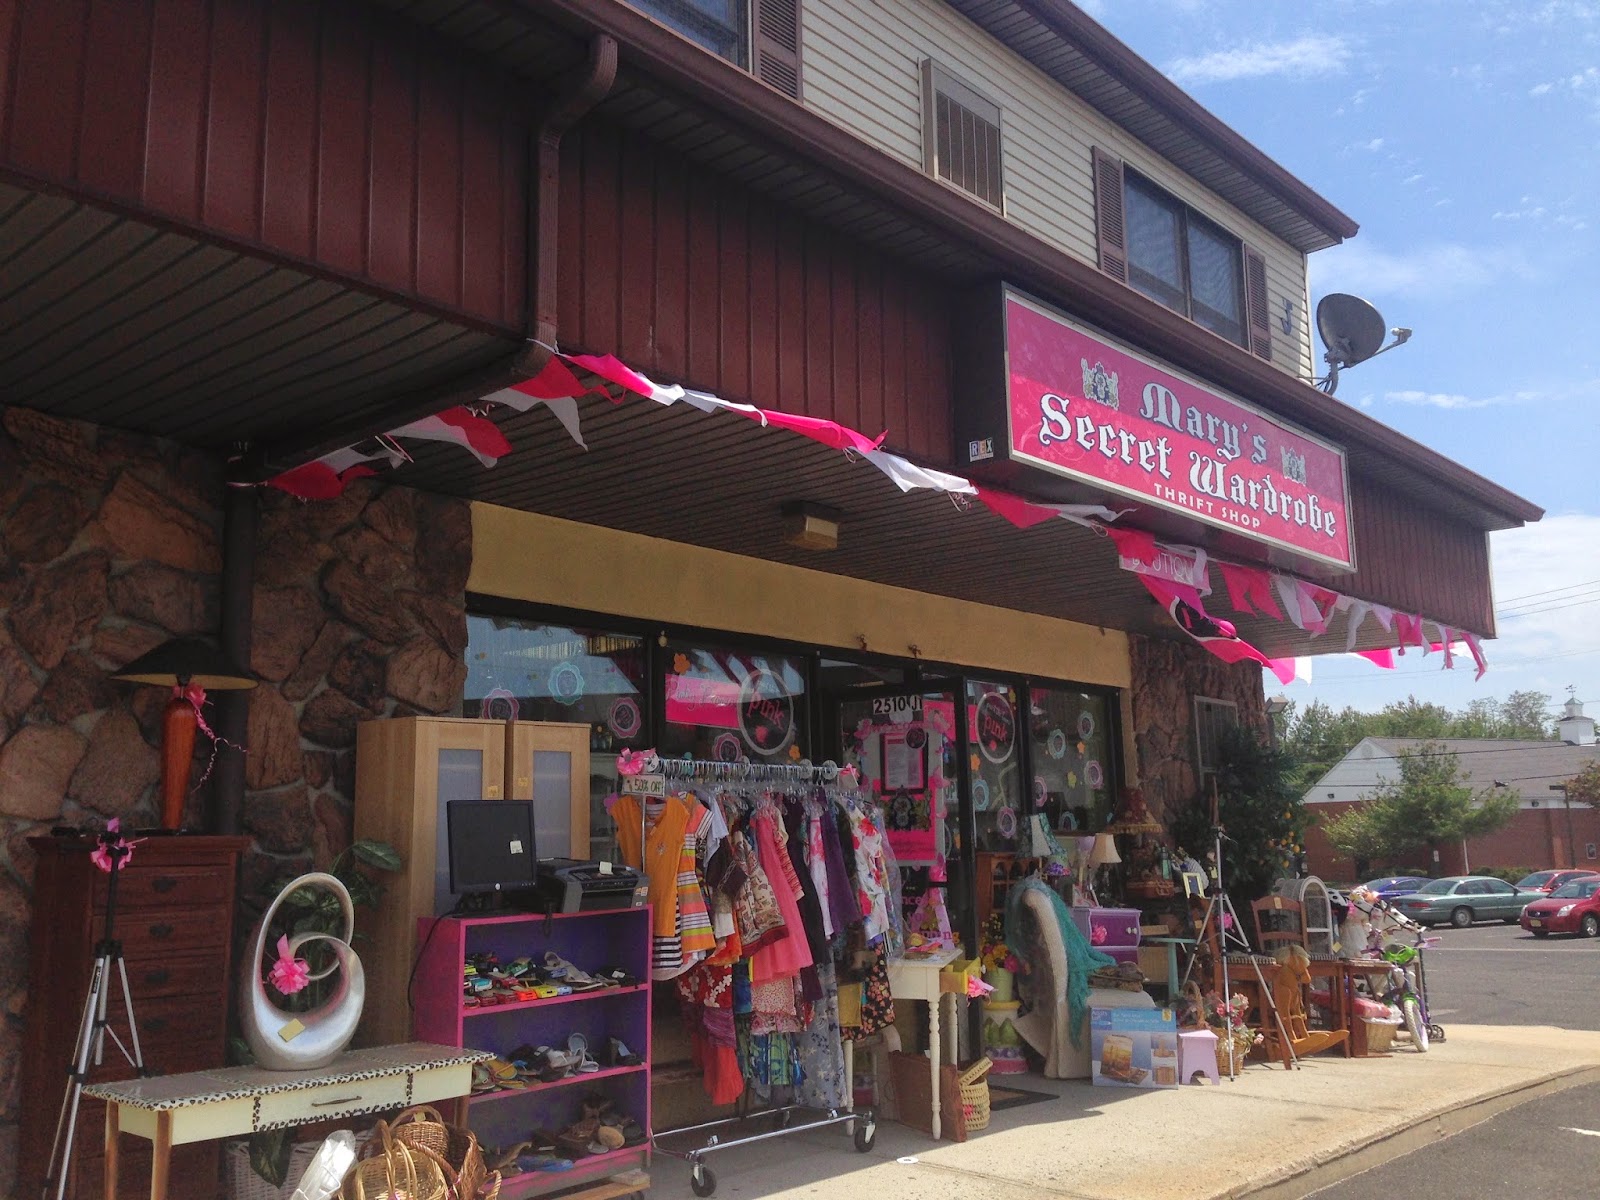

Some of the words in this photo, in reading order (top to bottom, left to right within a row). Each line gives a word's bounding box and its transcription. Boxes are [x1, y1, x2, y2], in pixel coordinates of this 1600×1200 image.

[1140, 383, 1267, 463] Mary's
[969, 439, 993, 457] REX
[1039, 393, 1172, 479] Secret
[1189, 452, 1336, 537] Wardrobe
[1153, 483, 1214, 515] THRIFT
[1221, 506, 1261, 529] SHOP
[873, 696, 906, 714] 2510
